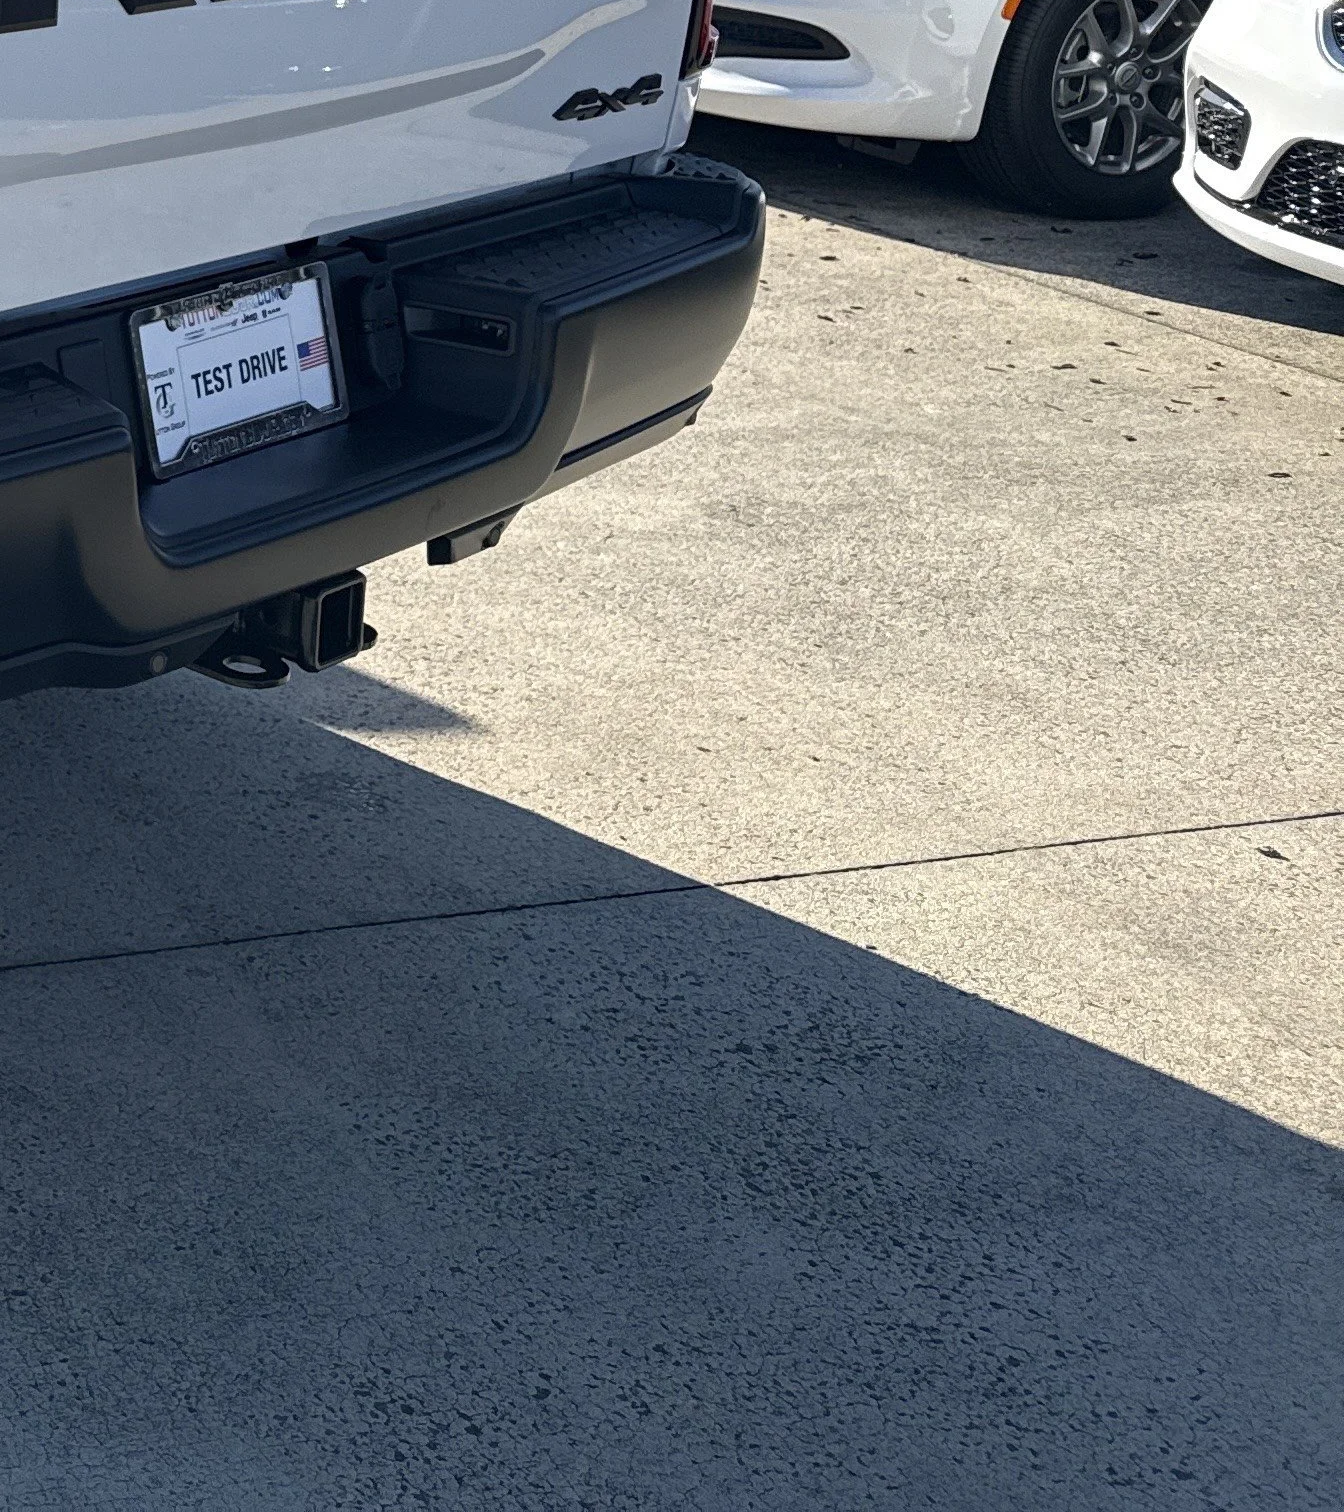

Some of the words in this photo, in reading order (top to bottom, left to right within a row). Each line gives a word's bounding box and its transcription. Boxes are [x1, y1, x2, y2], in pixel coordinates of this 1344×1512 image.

[241, 312, 258, 324] Jeep
[191, 362, 233, 399] TEST
[238, 346, 288, 384] DRIVE
